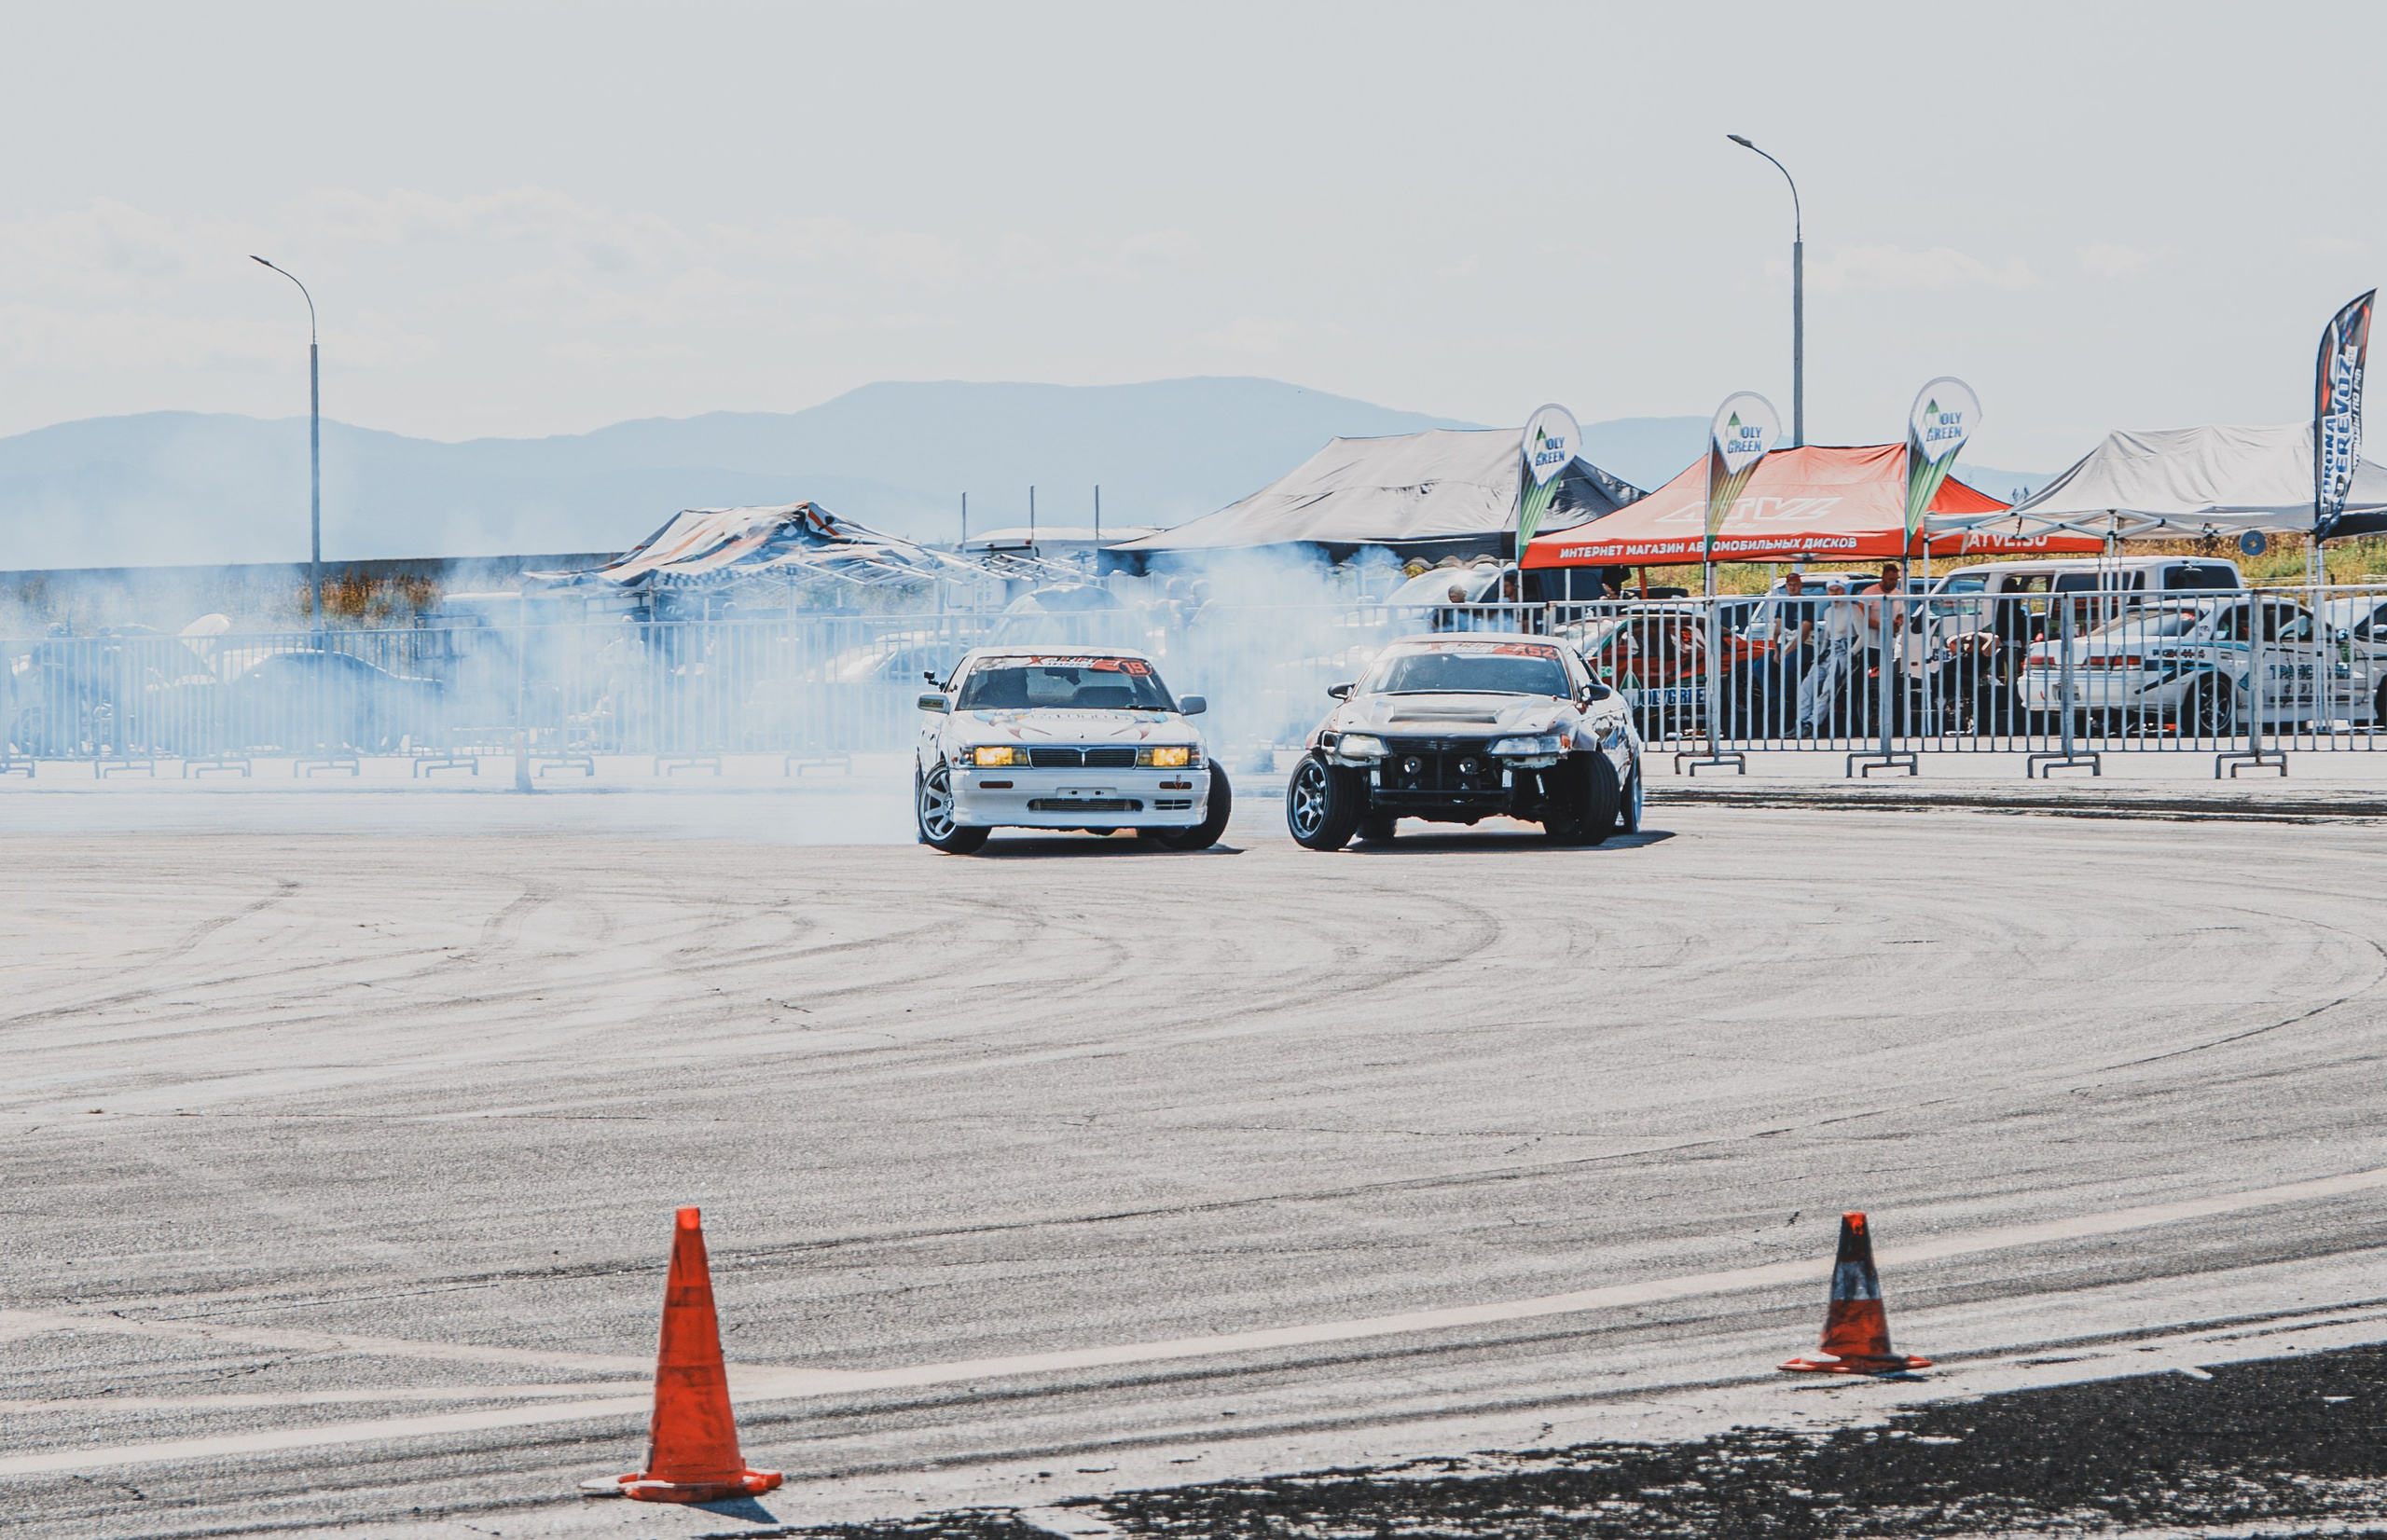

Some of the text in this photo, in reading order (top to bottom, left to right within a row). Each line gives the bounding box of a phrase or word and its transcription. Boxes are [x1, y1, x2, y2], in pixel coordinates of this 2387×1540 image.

[1925, 426, 1962, 442] GREEN
[1728, 439, 1761, 454] GREEN
[1536, 451, 1565, 466] GREEN
[1560, 537, 1857, 558] ИНТЕРНЕТ МАГАЗИН АВОМОБИЛЬНЫХ ДИСКОВ
[1122, 661, 1147, 674] 19
